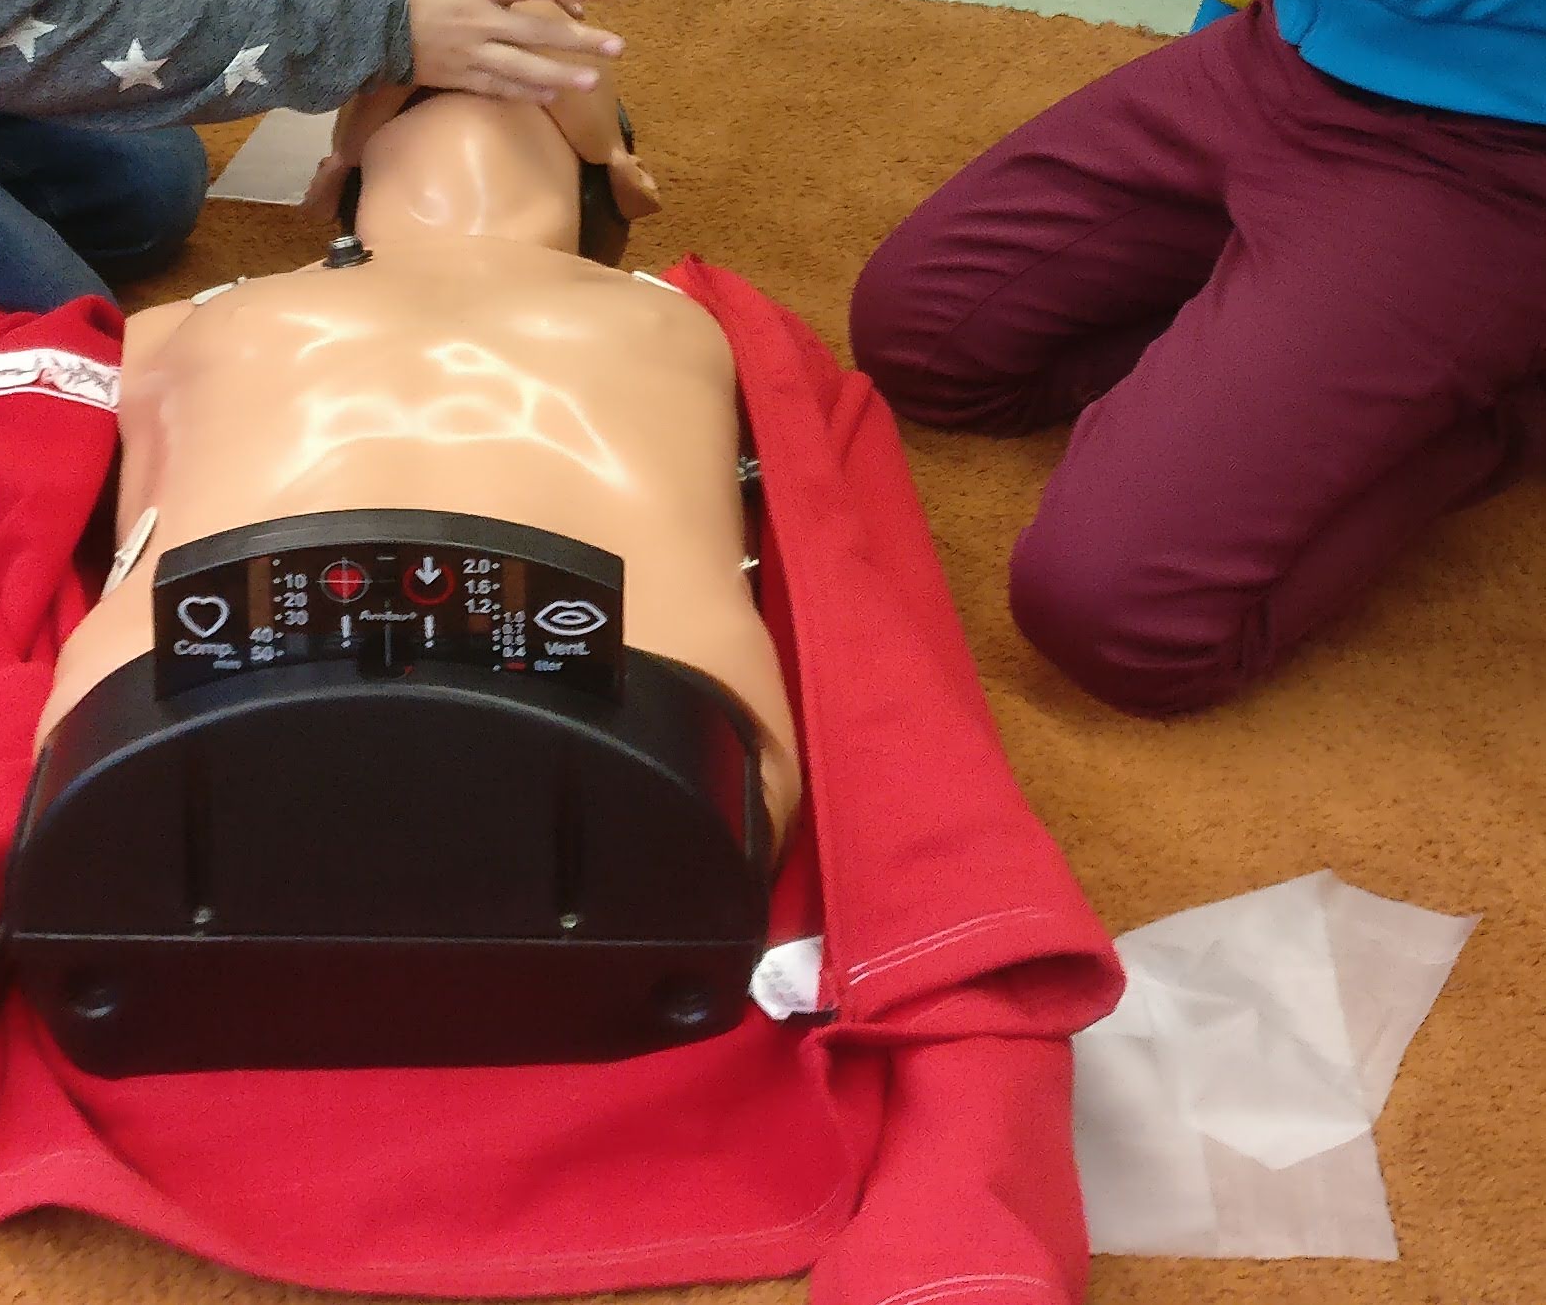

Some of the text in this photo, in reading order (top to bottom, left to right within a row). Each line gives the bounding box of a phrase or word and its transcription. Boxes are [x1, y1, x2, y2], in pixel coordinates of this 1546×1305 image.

[462, 558, 491, 574] 2.0
[284, 573, 308, 589] 10
[283, 592, 308, 607] 20
[464, 598, 492, 613] 1.2
[284, 609, 309, 625] 30
[250, 626, 274, 643] 40
[173, 639, 237, 658] Comp.
[250, 645, 275, 661] 50
